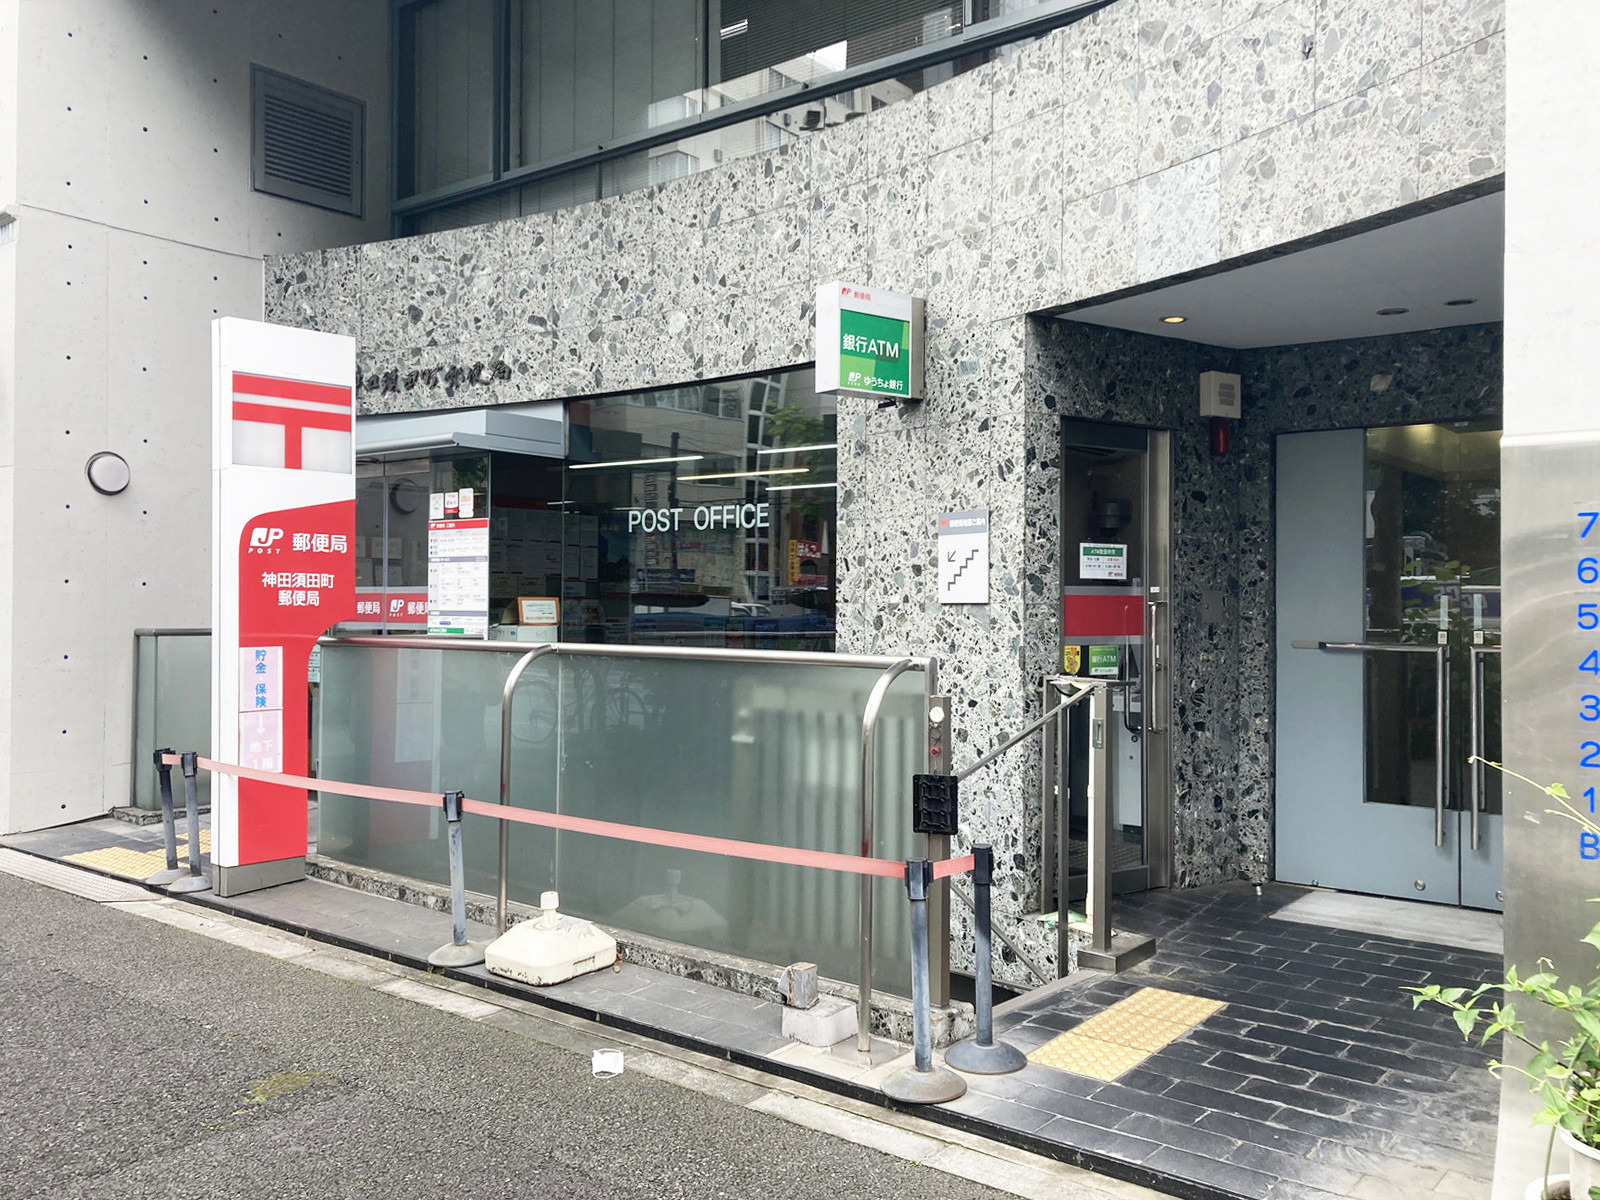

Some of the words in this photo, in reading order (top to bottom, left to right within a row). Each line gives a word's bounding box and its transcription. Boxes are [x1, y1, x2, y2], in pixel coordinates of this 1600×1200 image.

[843, 333, 899, 358] 銀行ATM
[863, 376, 903, 390] ゆうちょ銀行
[628, 508, 683, 533] POST
[693, 502, 770, 531] OFFICE
[1577, 511, 1600, 538] 7
[247, 547, 281, 555] POST
[292, 532, 348, 554] 郵便局
[261, 571, 335, 589] 神田須田町
[1577, 557, 1599, 584] 6
[277, 589, 320, 607] 郵便局
[1577, 603, 1599, 630] 5
[1578, 649, 1600, 676] 4
[1579, 694, 1600, 721] 3
[1579, 740, 1600, 768] 2
[1582, 786, 1596, 814] 1
[1579, 832, 1600, 860] B
